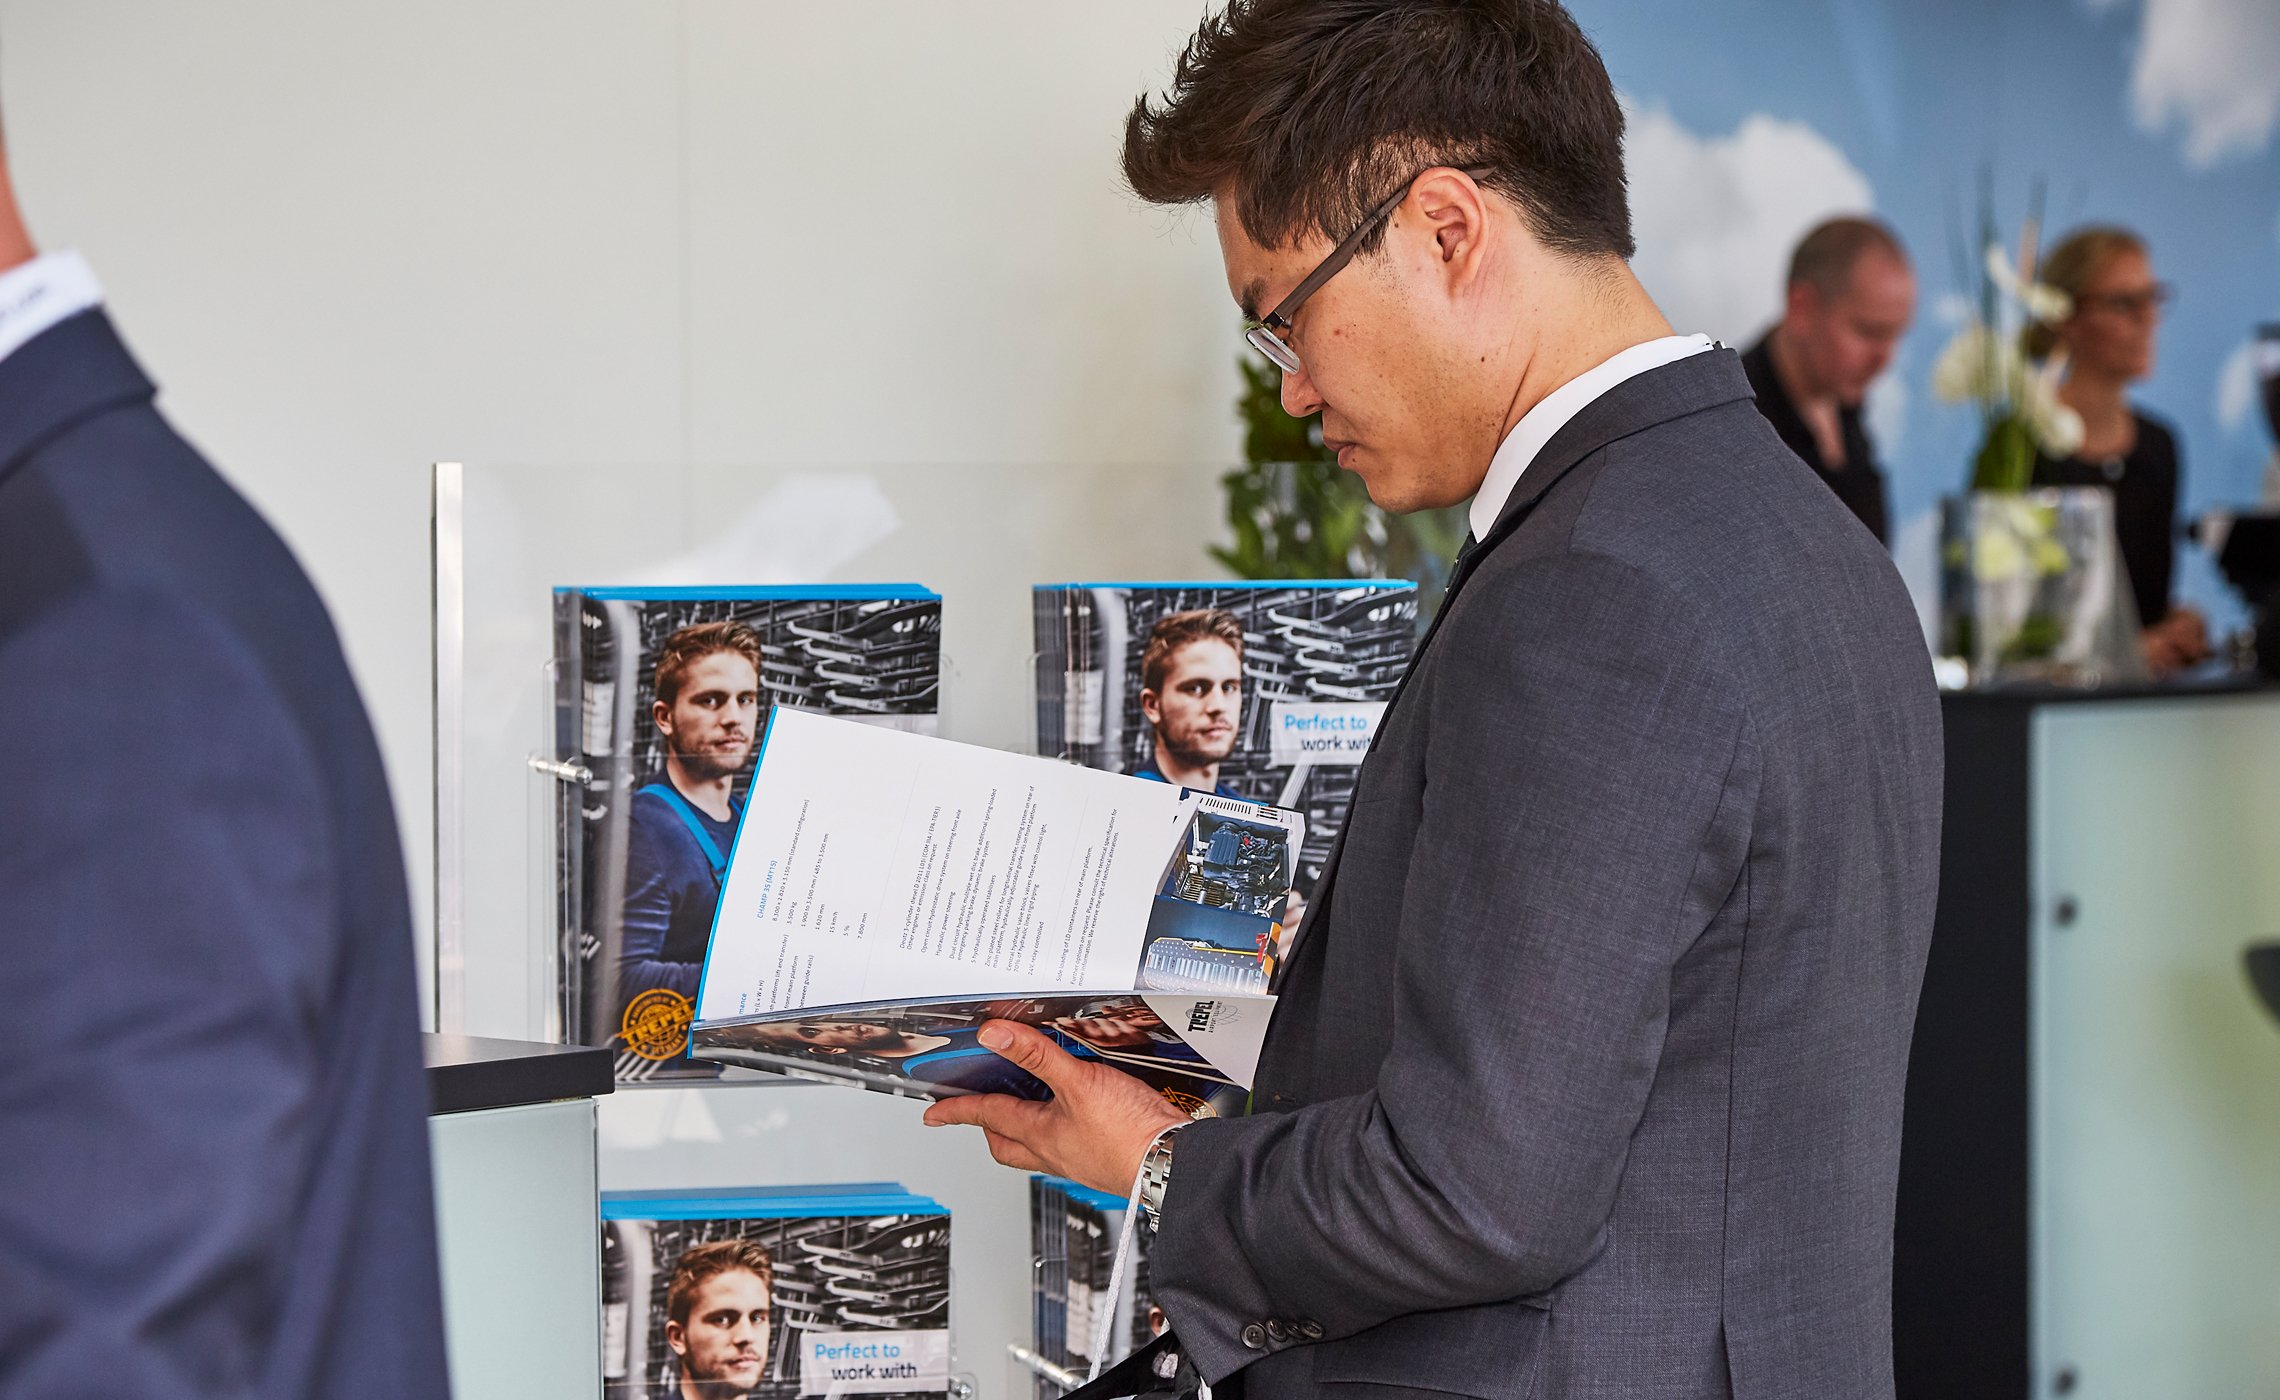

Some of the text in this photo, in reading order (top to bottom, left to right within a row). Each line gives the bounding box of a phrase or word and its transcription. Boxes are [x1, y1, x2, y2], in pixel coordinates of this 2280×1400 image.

[1284, 713, 1366, 730] Perfect to
[1302, 736, 1342, 750] work
[796, 799, 810, 833] configuration)
[788, 832, 800, 856] (standard
[1035, 836, 1044, 854] control
[787, 856, 792, 866] mm
[810, 878, 817, 889] mm
[823, 833, 829, 843] mm
[996, 905, 1004, 922] rollers
[1001, 866, 1013, 896] longitudinal
[1015, 826, 1025, 846] rotating
[1000, 896, 1014, 929] hydraulically
[1010, 869, 1020, 896] adjustable
[1028, 803, 1037, 825] platform
[1027, 865, 1036, 879] fitted
[757, 860, 778, 919] CHAMP 35 (MY15)
[906, 934, 914, 950] Other
[911, 913, 920, 934] engines
[918, 883, 927, 906] emission
[929, 844, 938, 863] request
[910, 888, 918, 905] diesel
[915, 870, 924, 883] 2011
[920, 938, 929, 953] Open
[928, 892, 940, 920] hydrostatic
[946, 832, 957, 852] steering
[949, 946, 957, 959] Dual
[956, 904, 967, 929] hydraulic
[963, 882, 972, 904] multiple
[978, 821, 988, 846] additional
[957, 930, 969, 961] emergency
[964, 910, 974, 931] parking
[972, 873, 982, 894] dynamic
[982, 840, 990, 858] system
[1070, 965, 1079, 985] Further
[1075, 944, 1084, 964] options
[1080, 936, 1085, 944] on
[1086, 896, 1095, 914] Please
[1091, 878, 1100, 897] consult
[1098, 846, 1108, 869] technical
[1104, 816, 1115, 846] specification
[1088, 929, 1094, 938] We
[1091, 909, 1099, 929] reserve
[1102, 858, 1112, 881] technical
[819, 903, 825, 915] mm
[861, 912, 868, 924] mm
[935, 931, 946, 956] Hydraulic
[946, 891, 956, 913] steering
[972, 874, 996, 959] hydraulically operated stabilisers
[1018, 927, 1028, 952] hydraulic
[1023, 913, 1032, 926] lines
[1030, 884, 1040, 901] piping
[1067, 906, 1078, 934] containers
[1010, 926, 1021, 951] hydraulic
[1034, 921, 1044, 949] controlled
[1064, 933, 1071, 942] LD
[770, 978, 779, 1004] platforms
[779, 934, 789, 958] transfer)
[790, 955, 798, 980] platform
[1006, 951, 1015, 971] Central
[1059, 948, 1069, 969] loading
[1188, 1001, 1214, 1031] TREPEL
[815, 1342, 900, 1359] Perfect to
[832, 1362, 918, 1380] work with
